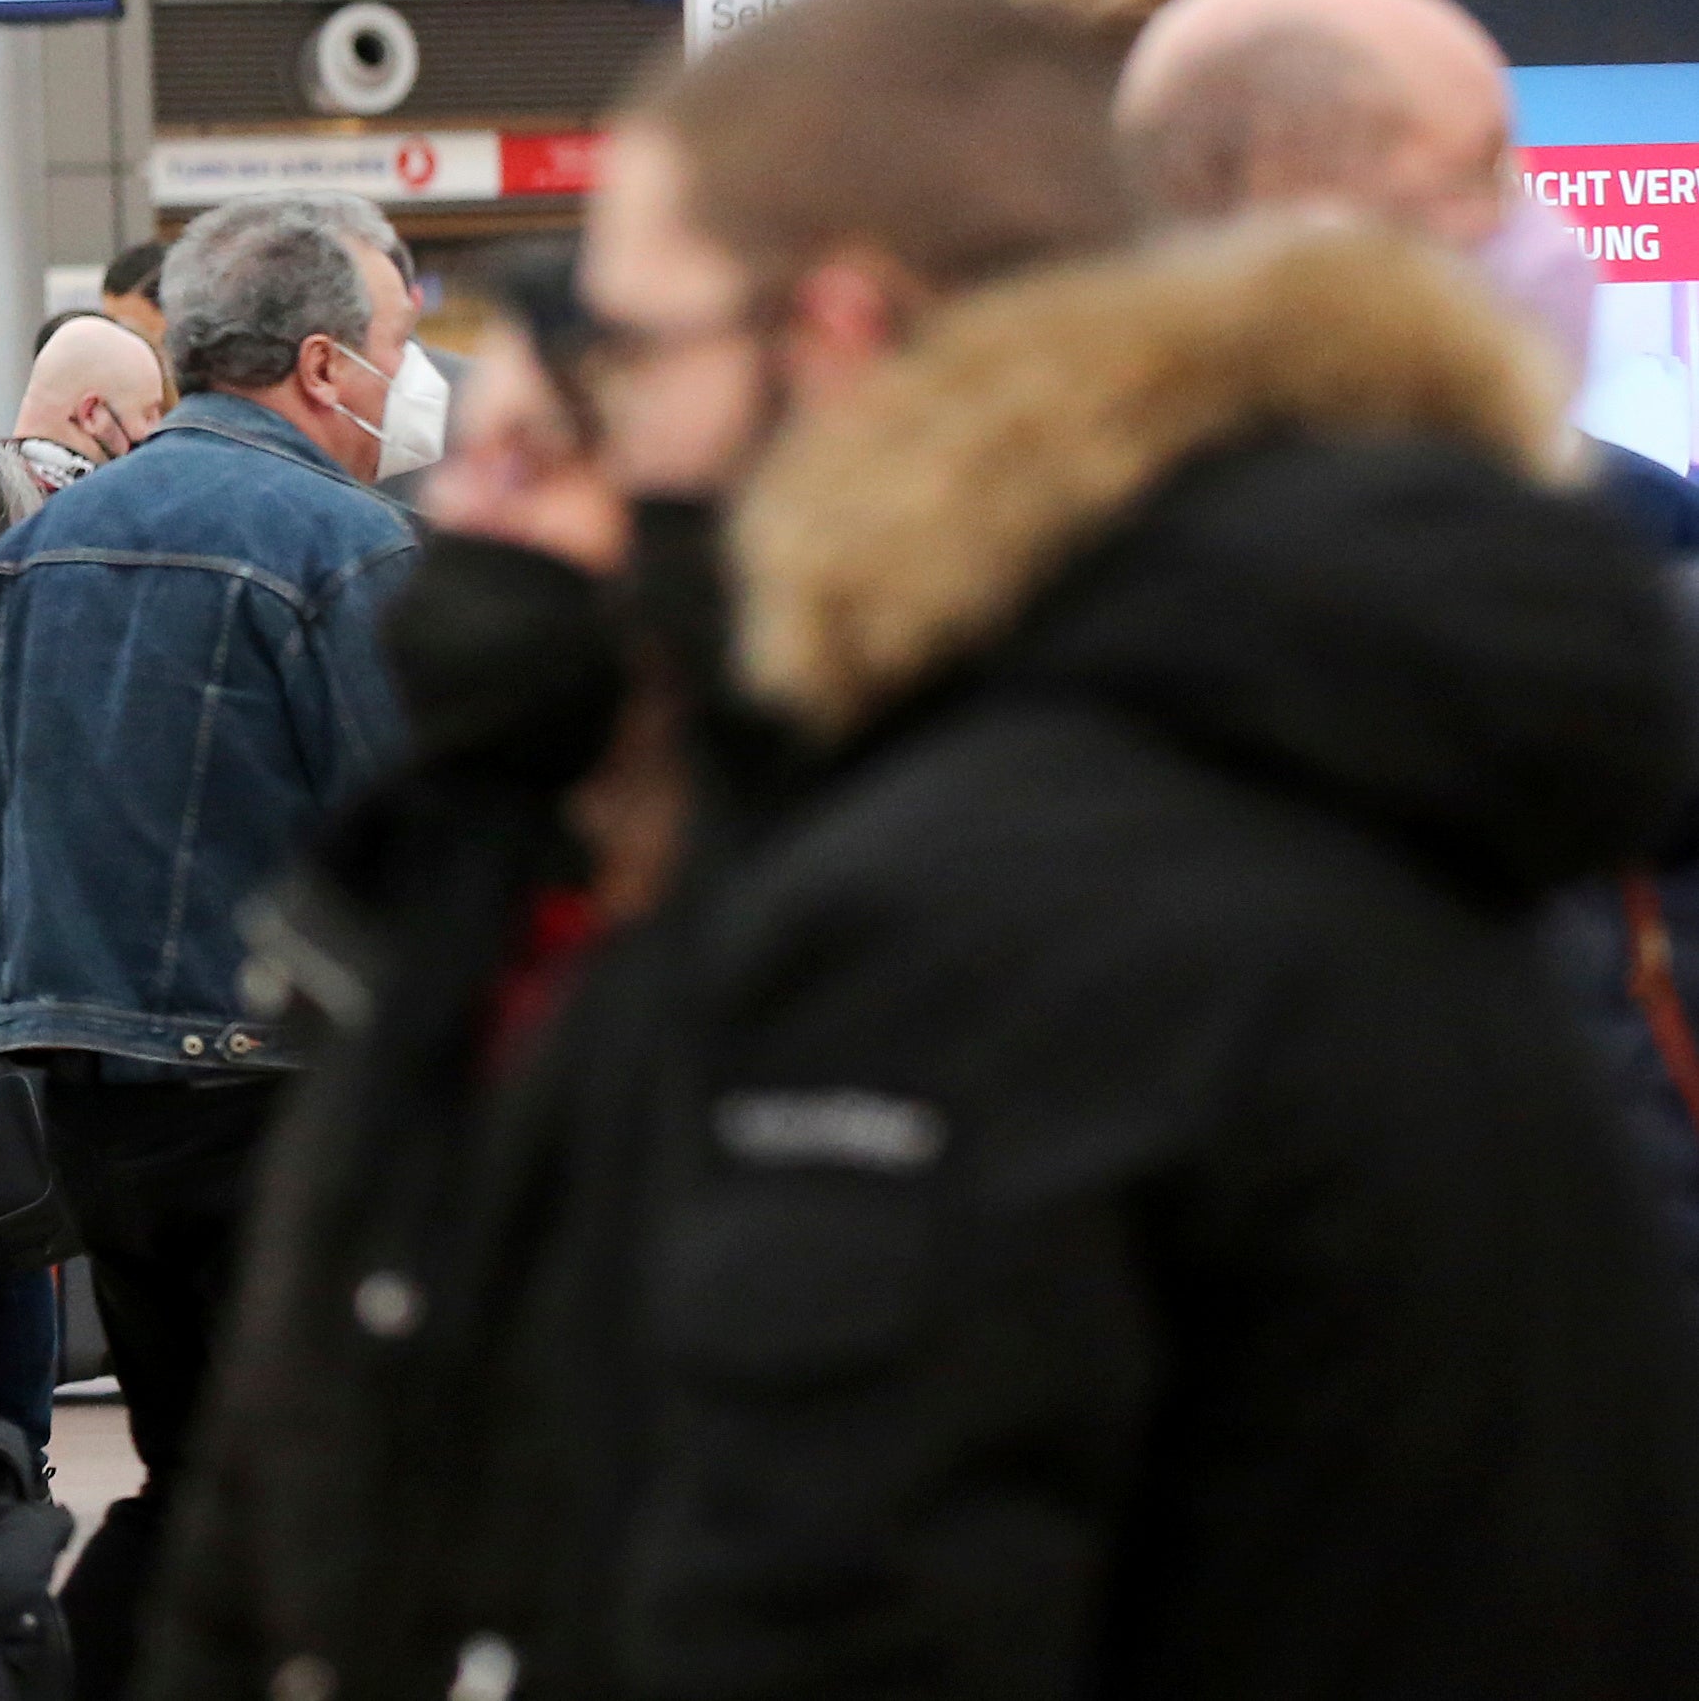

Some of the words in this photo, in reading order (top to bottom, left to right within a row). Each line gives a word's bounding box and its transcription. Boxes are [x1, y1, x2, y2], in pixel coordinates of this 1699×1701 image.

[1522, 169, 1612, 207] ICHT
[1617, 167, 1699, 205] VER
[1563, 223, 1661, 262] UNG
